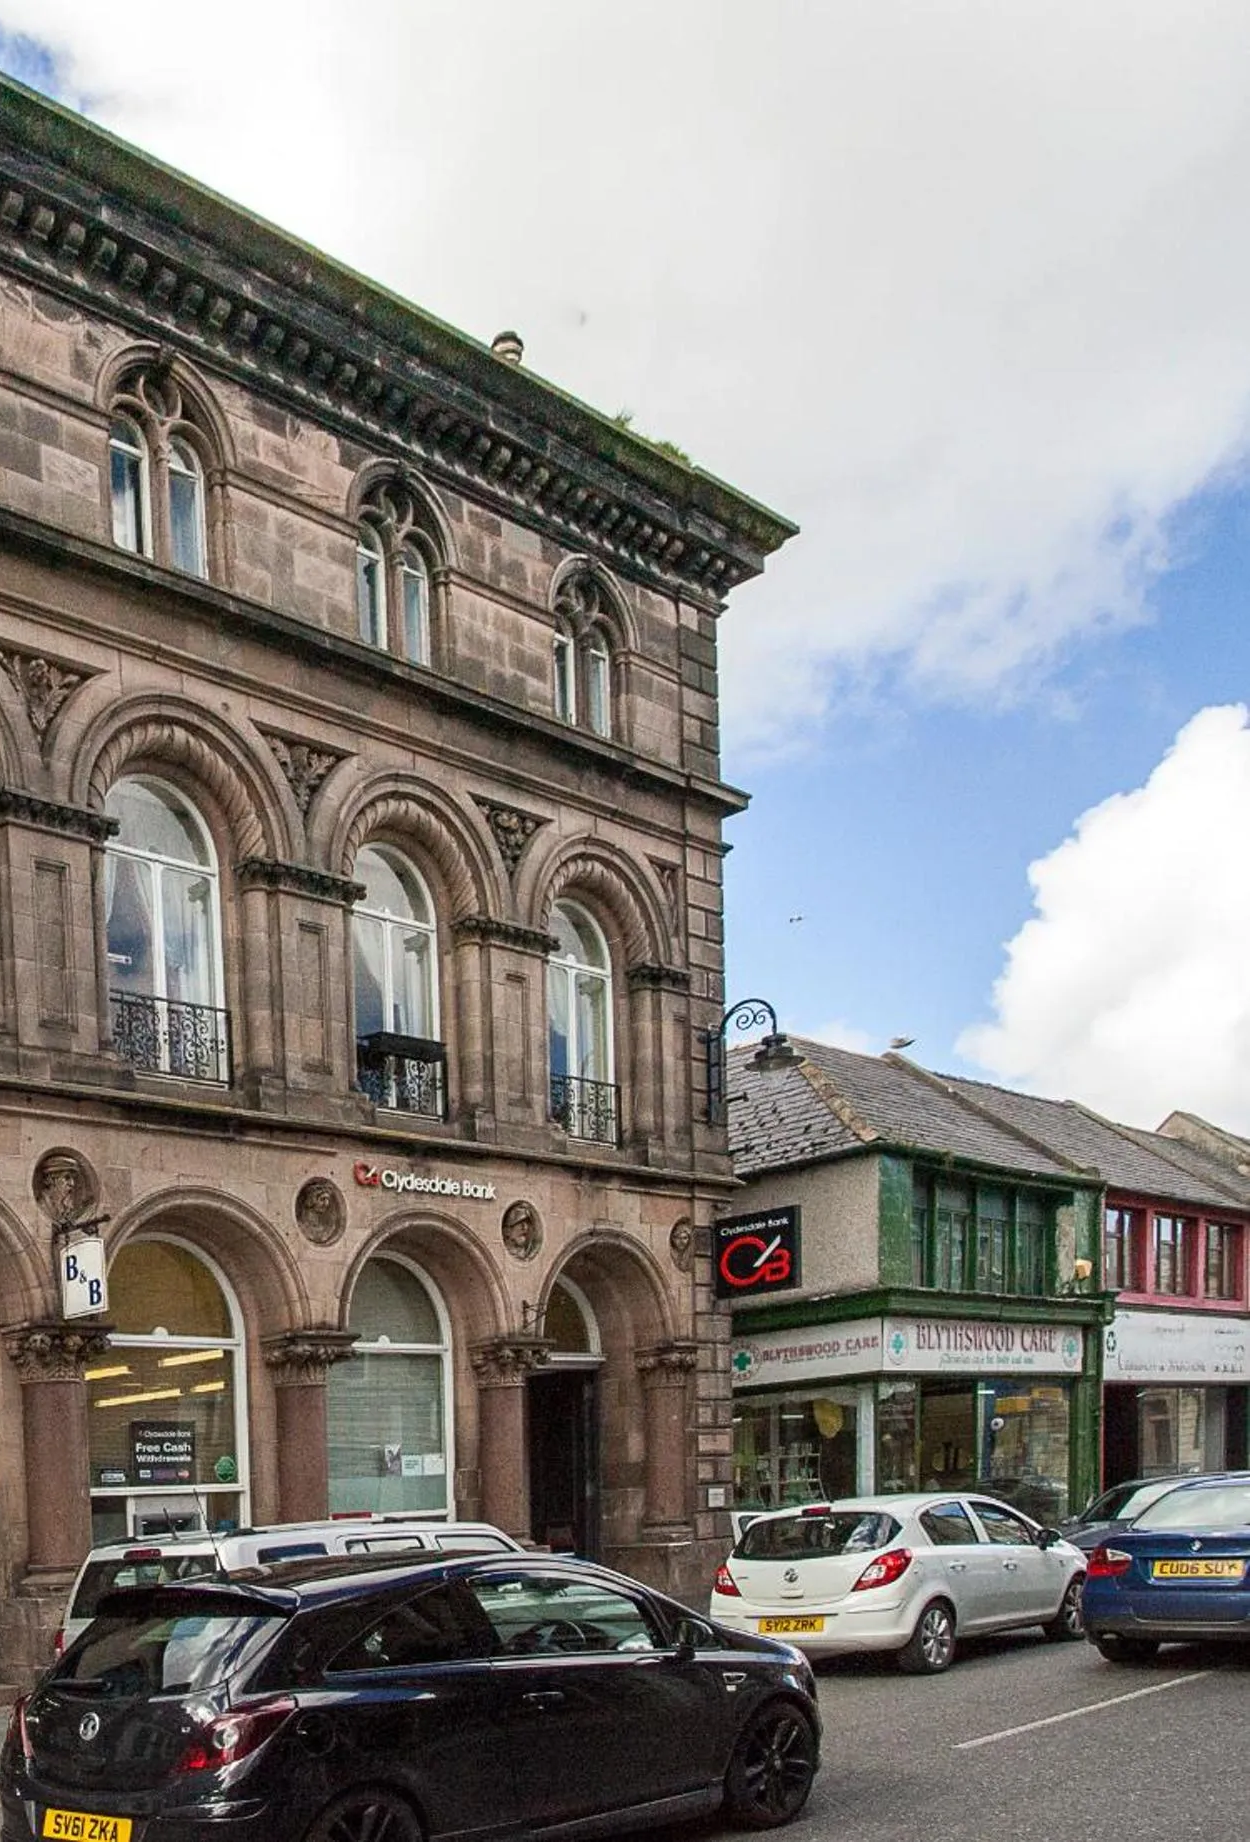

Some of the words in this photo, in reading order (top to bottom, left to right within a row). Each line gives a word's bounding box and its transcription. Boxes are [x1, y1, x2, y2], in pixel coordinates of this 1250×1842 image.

[381, 1169, 459, 1195] Clydesdale
[462, 1180, 497, 1200] Bank
[768, 1216, 789, 1228] Bank
[916, 1324, 1015, 1352] BLYTHSWOOD
[1020, 1325, 1057, 1353] CARE
[762, 1340, 841, 1361] BLYTHSWOOD
[845, 1336, 879, 1350] CARE
[135, 1442, 161, 1453] Free
[162, 1442, 191, 1453] Cash
[136, 1454, 192, 1463] Withdrawals
[765, 1619, 791, 1631] SY12
[53, 1814, 85, 1837] SV61
[88, 1818, 119, 1842] ZKA
